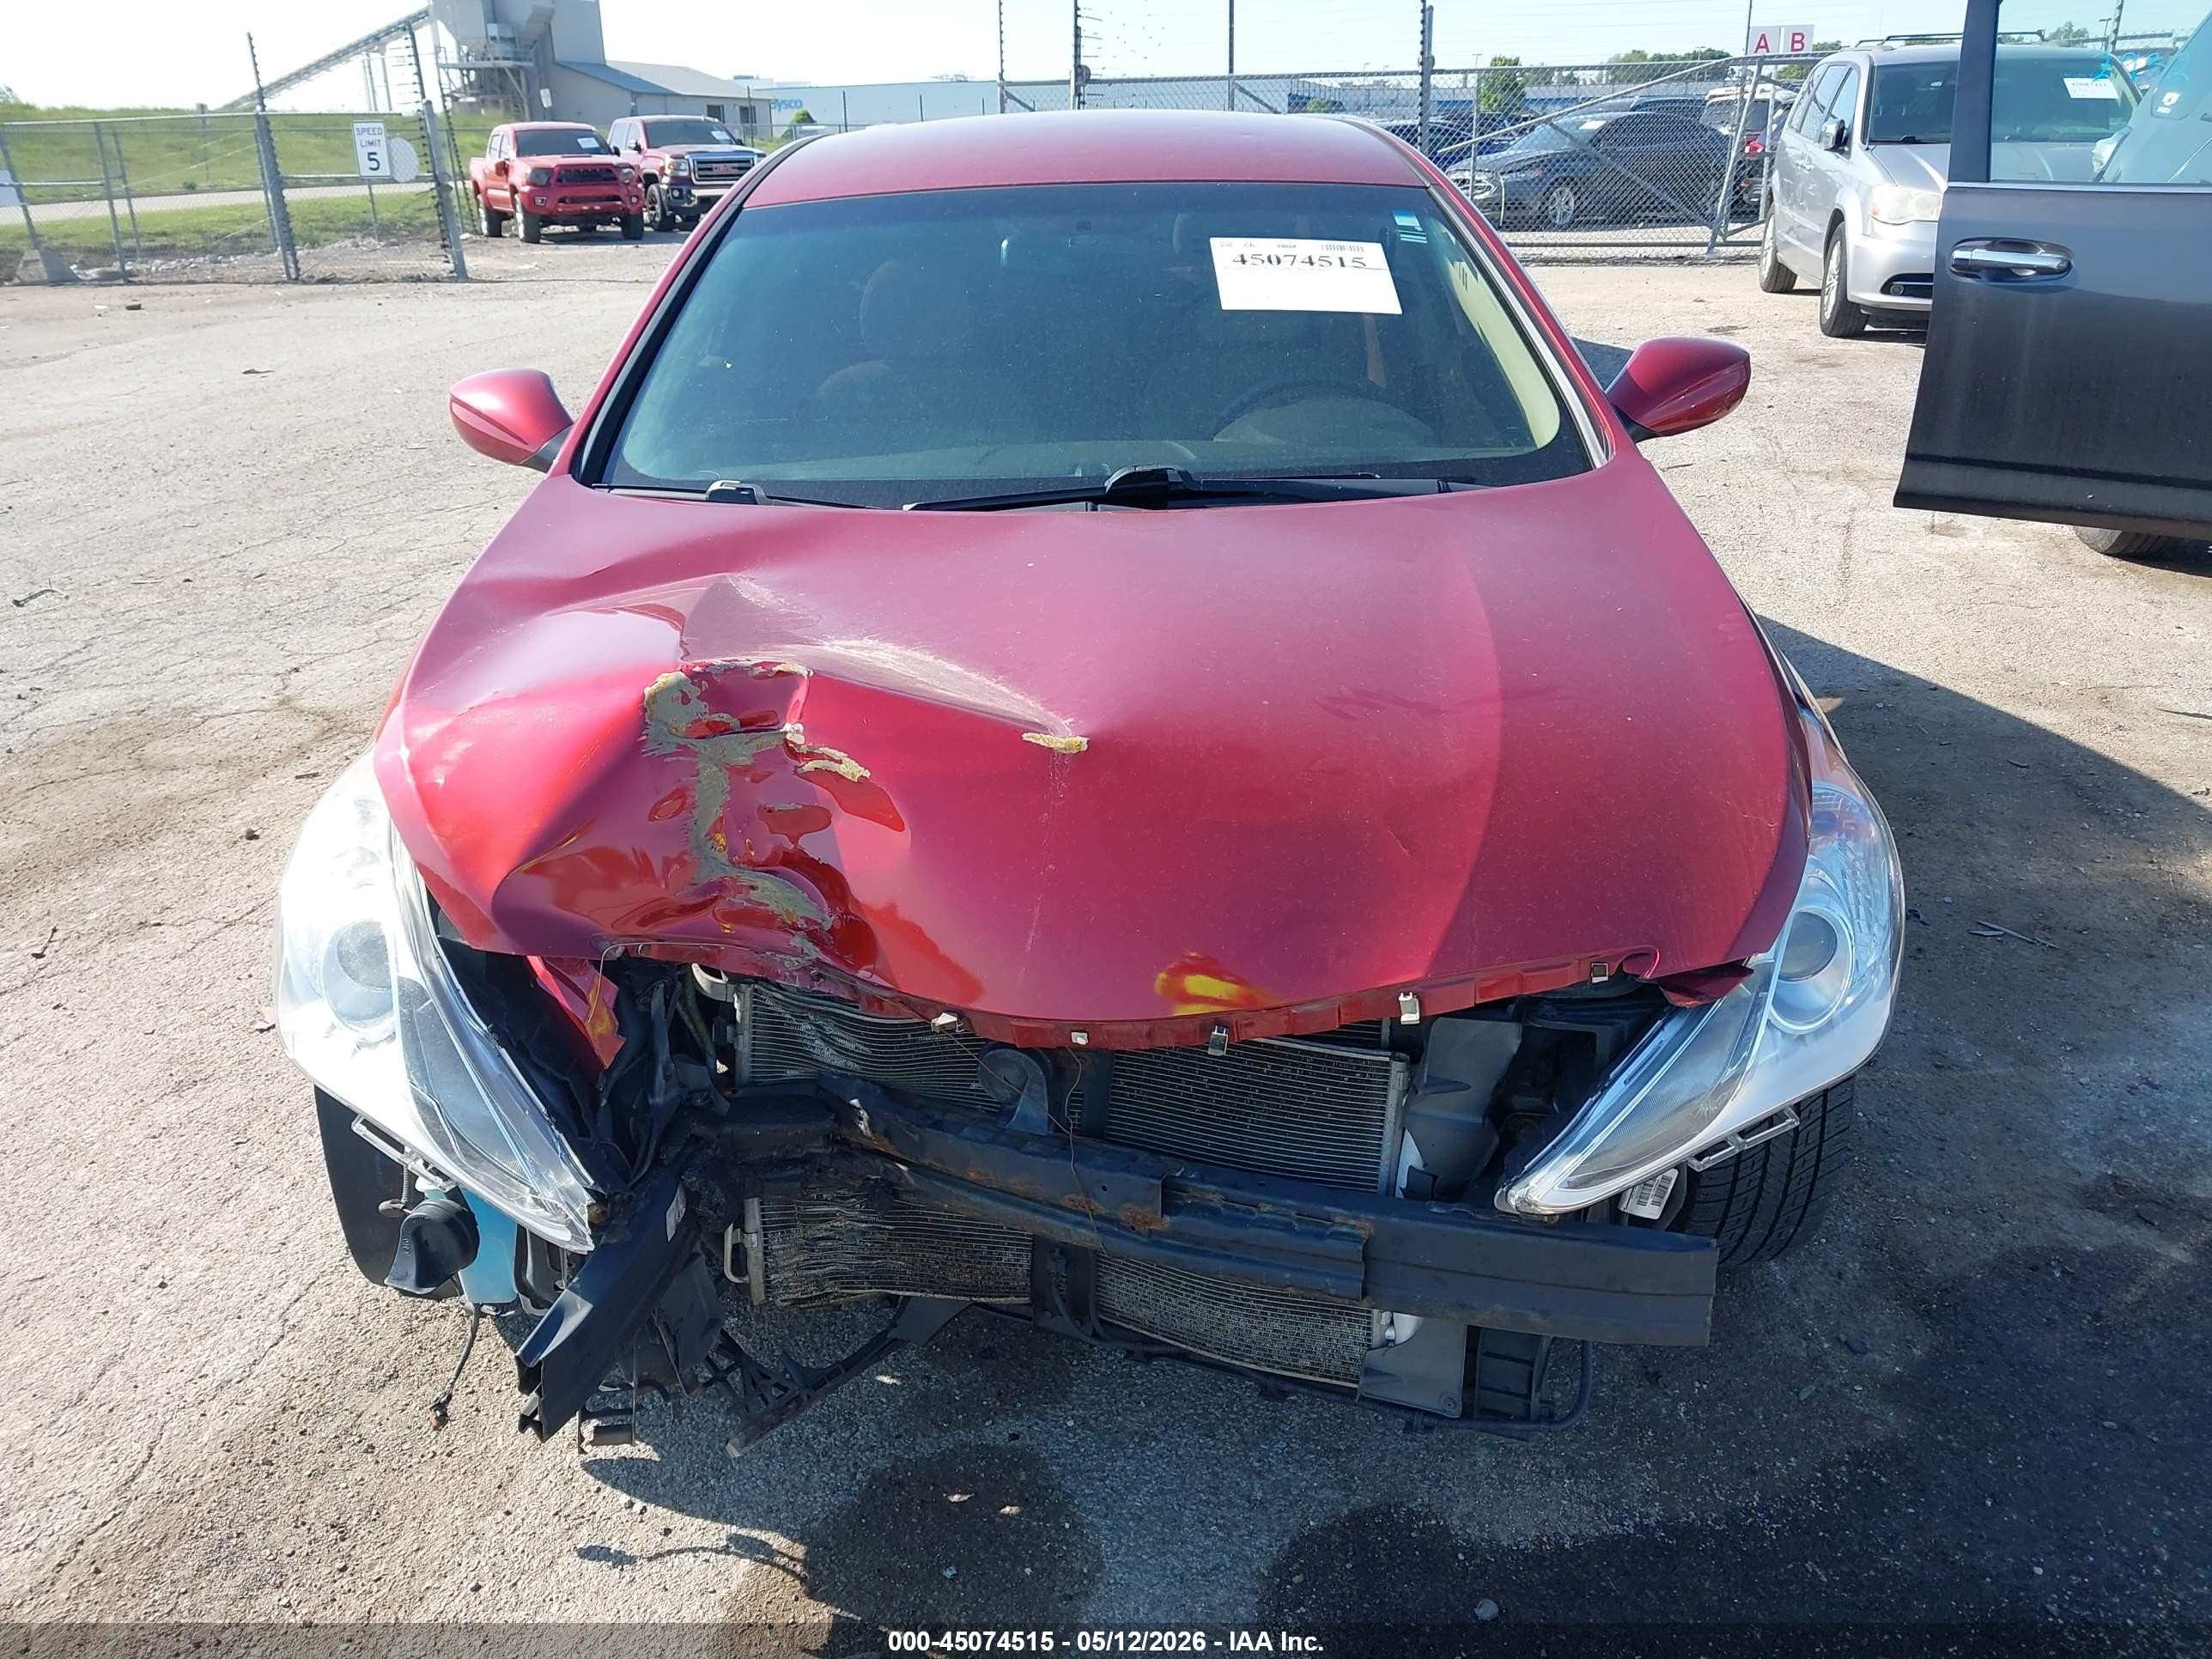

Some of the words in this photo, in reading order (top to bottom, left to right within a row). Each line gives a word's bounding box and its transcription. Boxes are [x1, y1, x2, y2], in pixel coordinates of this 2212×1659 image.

[1753, 33, 1770, 53] A
[1790, 32, 1805, 52] B
[356, 127, 383, 136] SPEED
[361, 139, 381, 148] LIMIT
[368, 152, 380, 171] 5
[1232, 253, 1367, 269] 45074515
